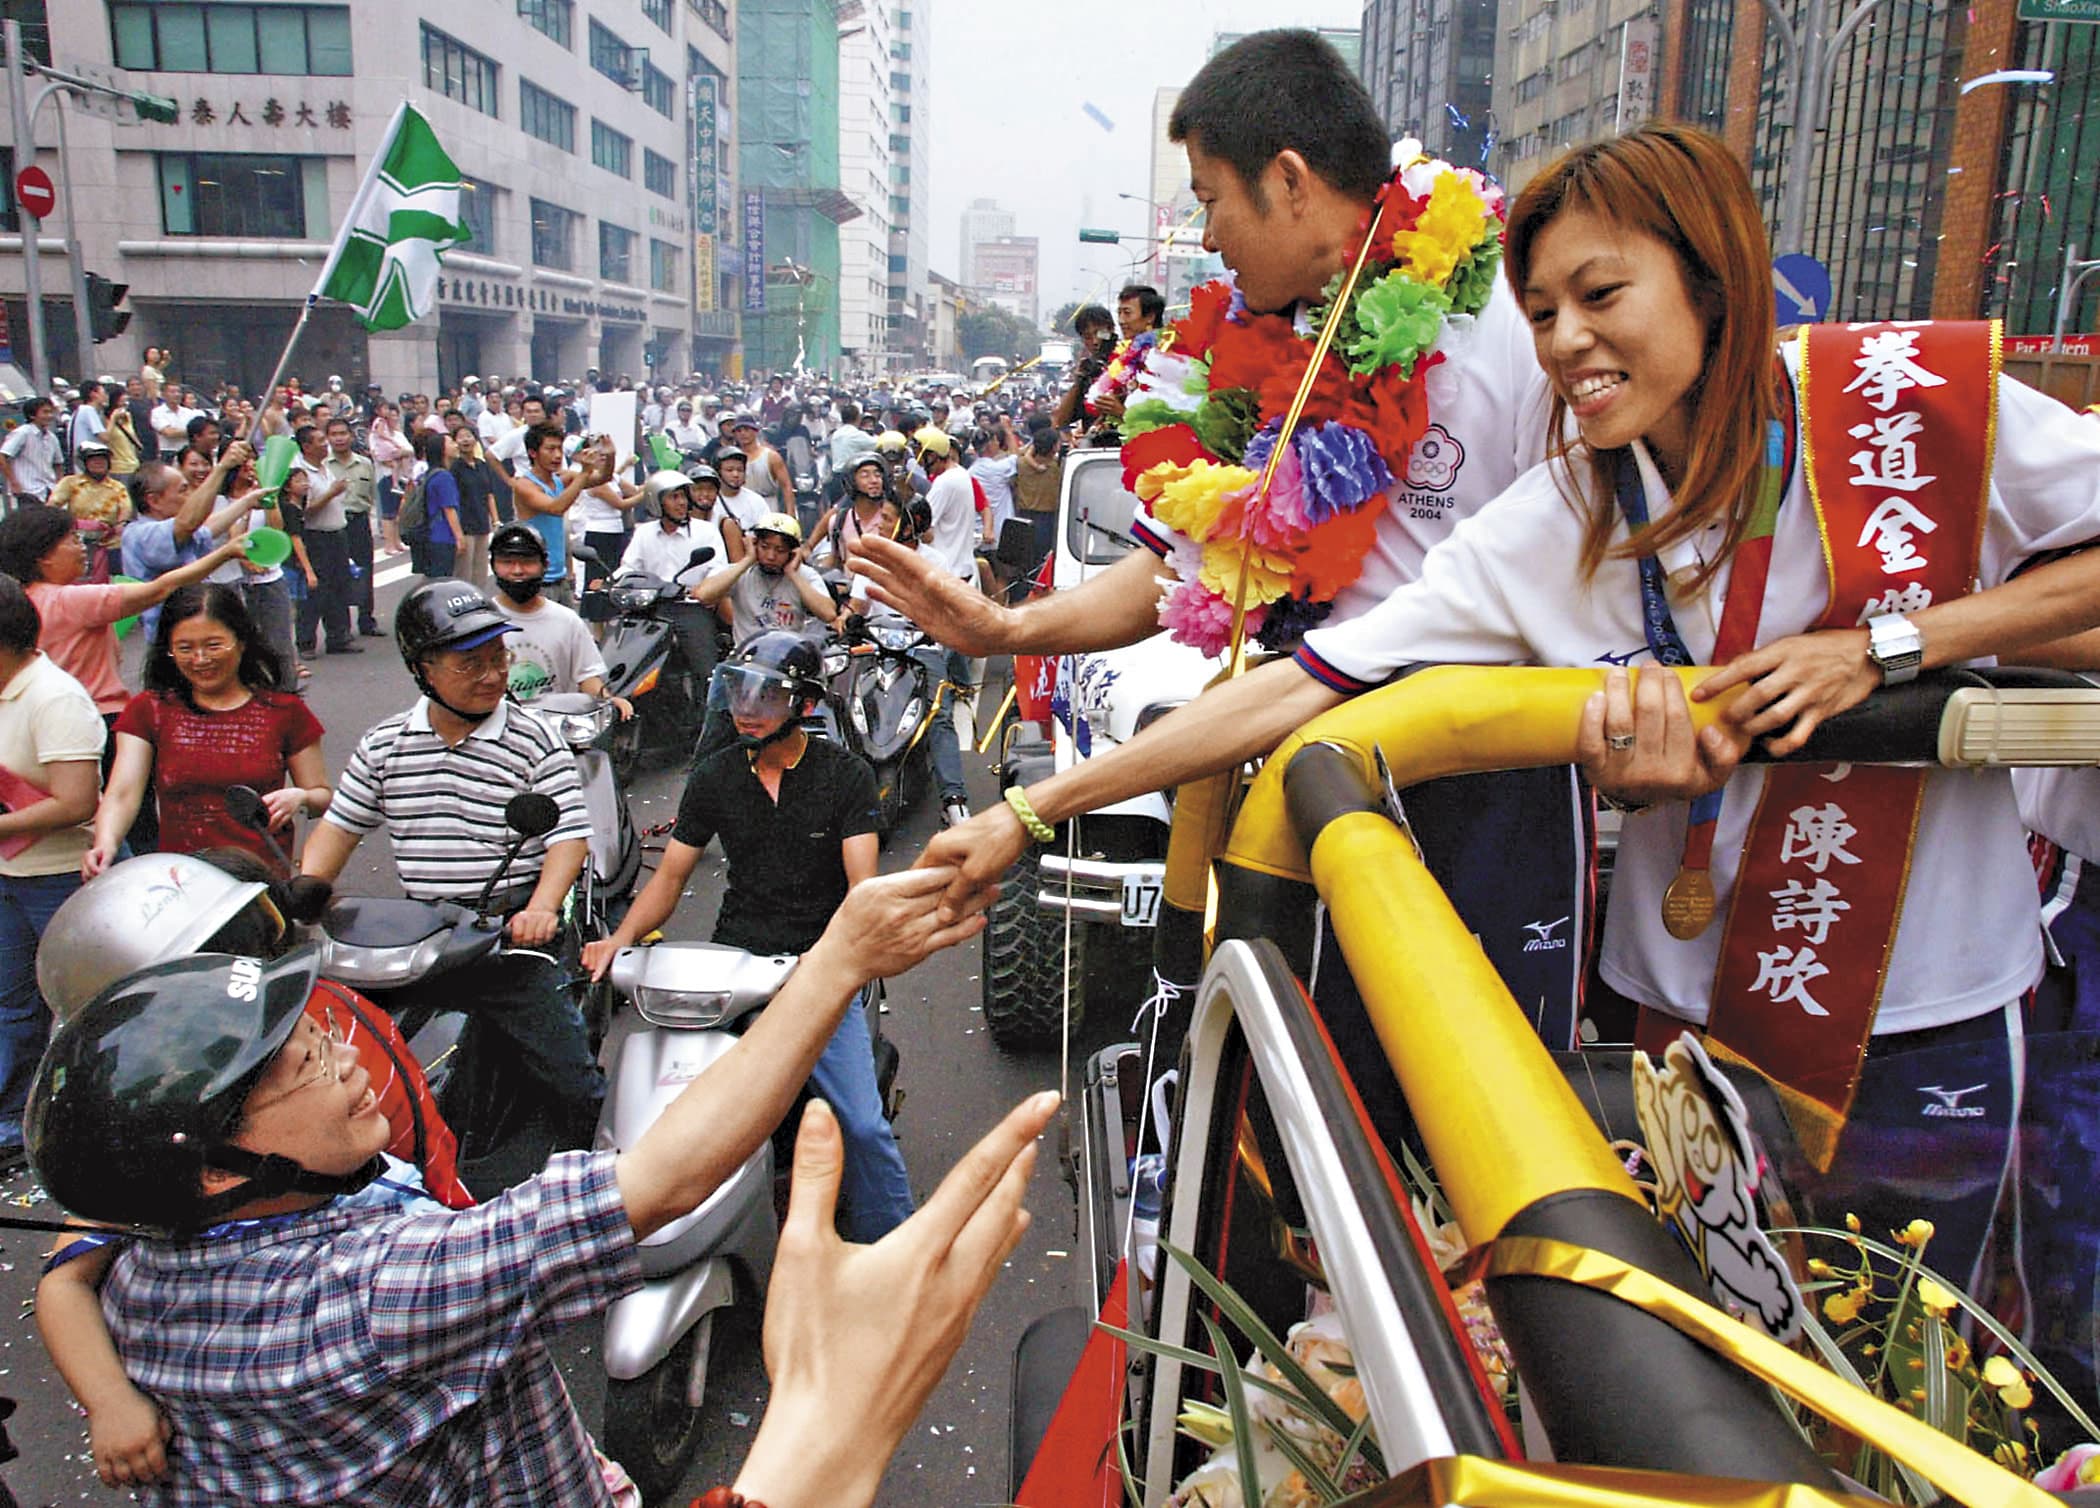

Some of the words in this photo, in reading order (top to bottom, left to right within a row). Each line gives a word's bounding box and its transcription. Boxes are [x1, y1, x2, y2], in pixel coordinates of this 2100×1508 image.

[176, 97, 353, 130] 泰人壽大樓
[1398, 492, 1455, 509] ATHENS
[1410, 507, 1442, 520] 2004
[1748, 802, 1863, 1016] 陳詩欣
